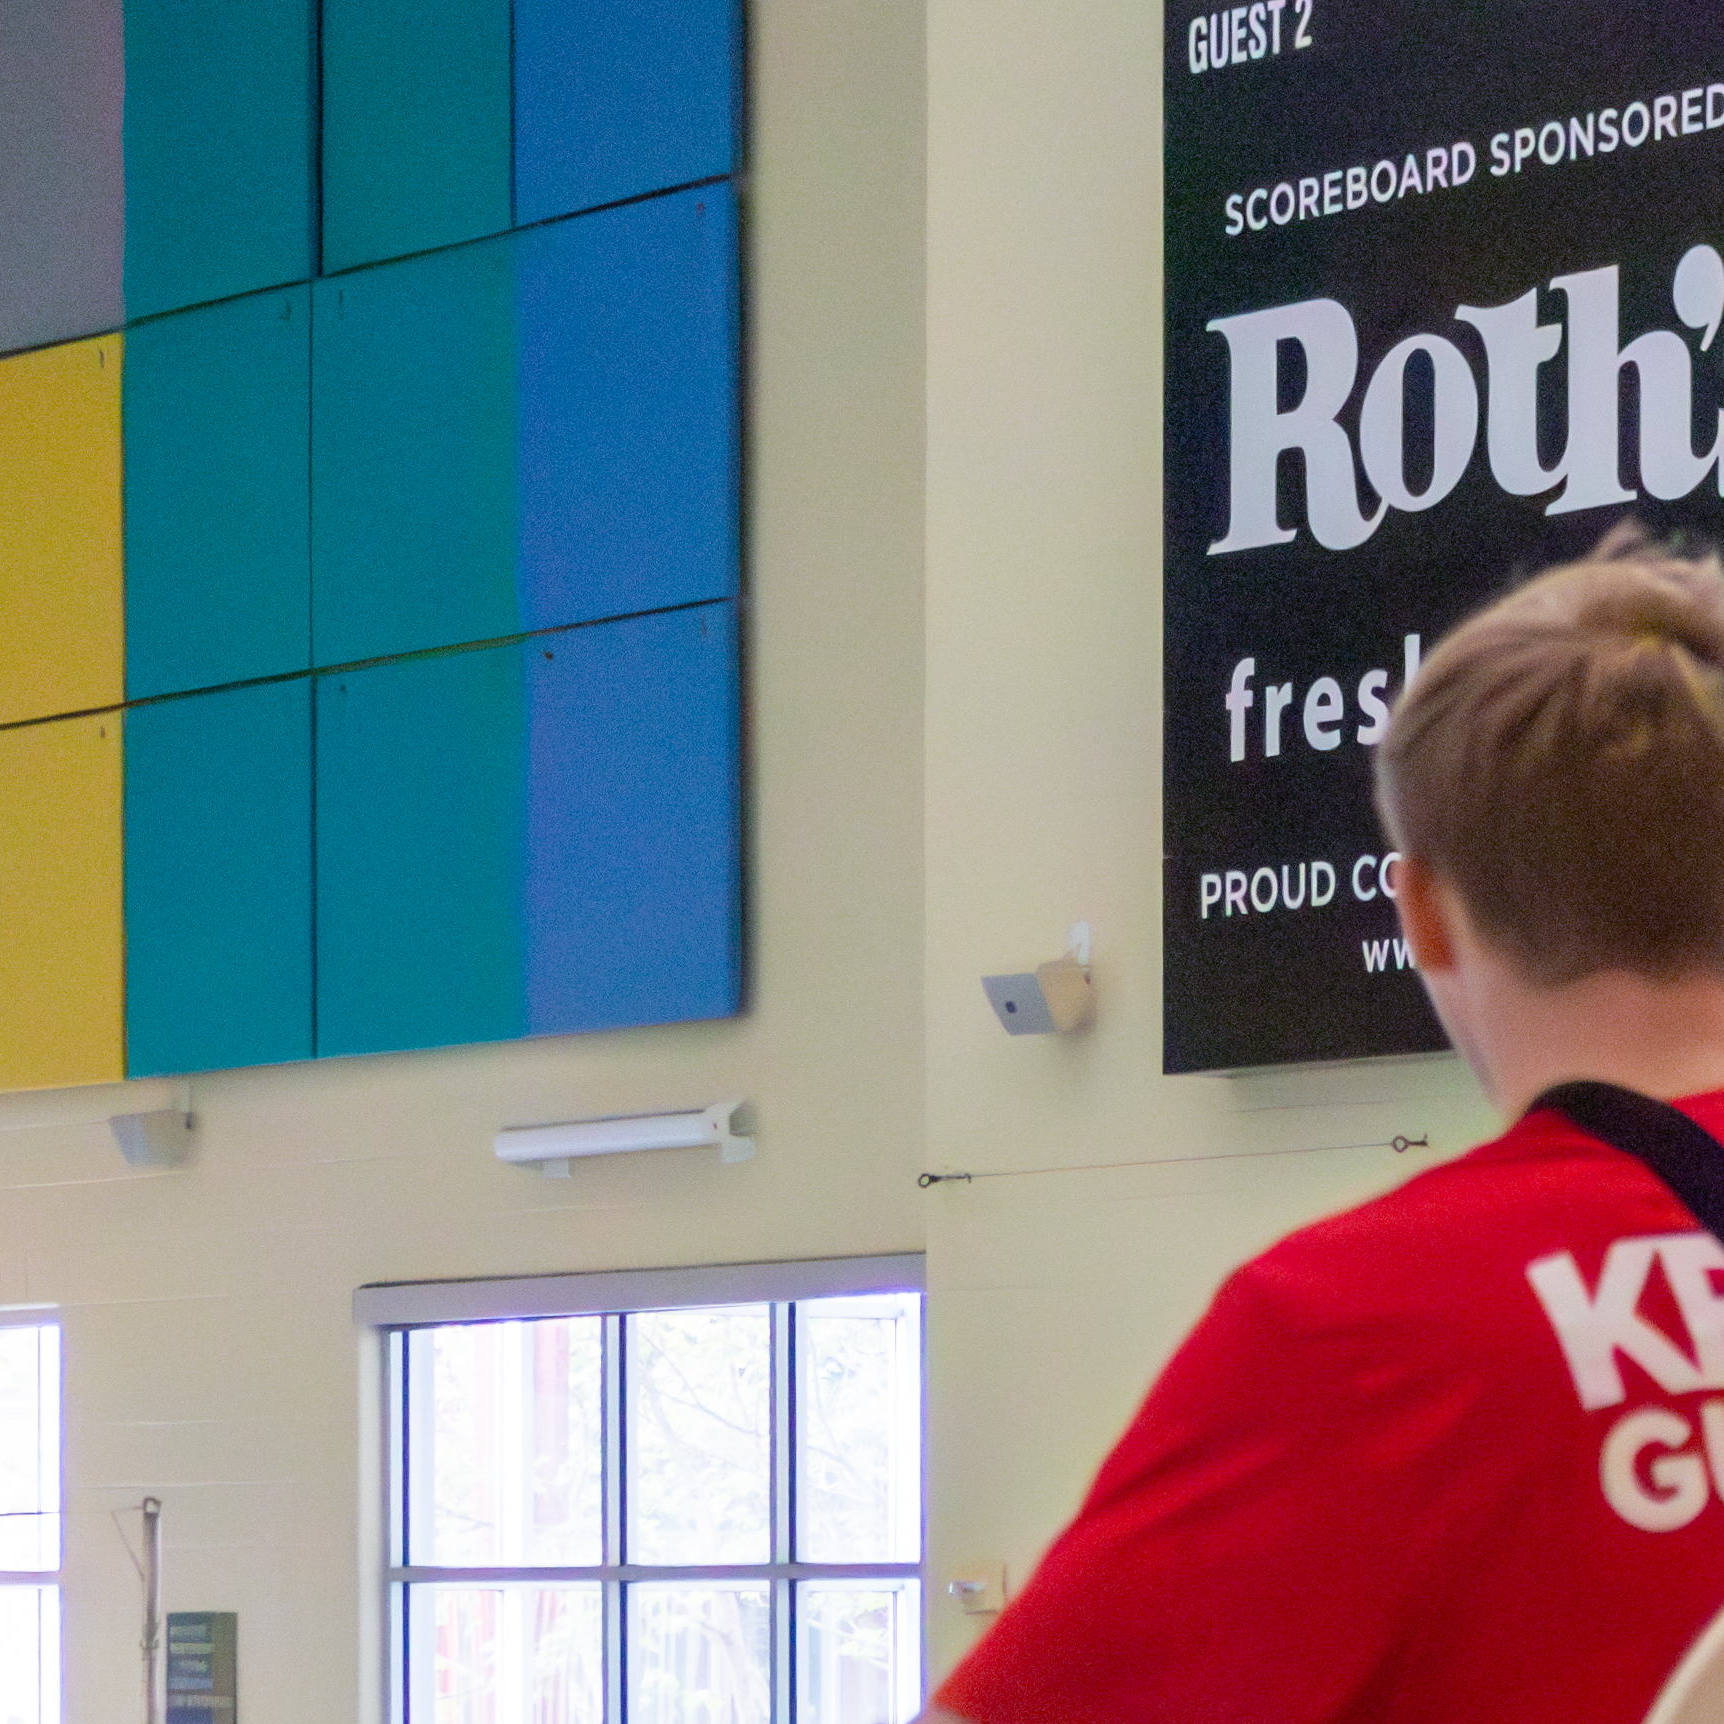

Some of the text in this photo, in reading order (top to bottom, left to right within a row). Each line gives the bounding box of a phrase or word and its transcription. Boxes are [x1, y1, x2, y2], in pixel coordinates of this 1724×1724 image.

[1188, 0, 1313, 74] GUEST 2
[1224, 142, 1476, 236] SCOREBOARD
[1200, 861, 1336, 919] PROUD
